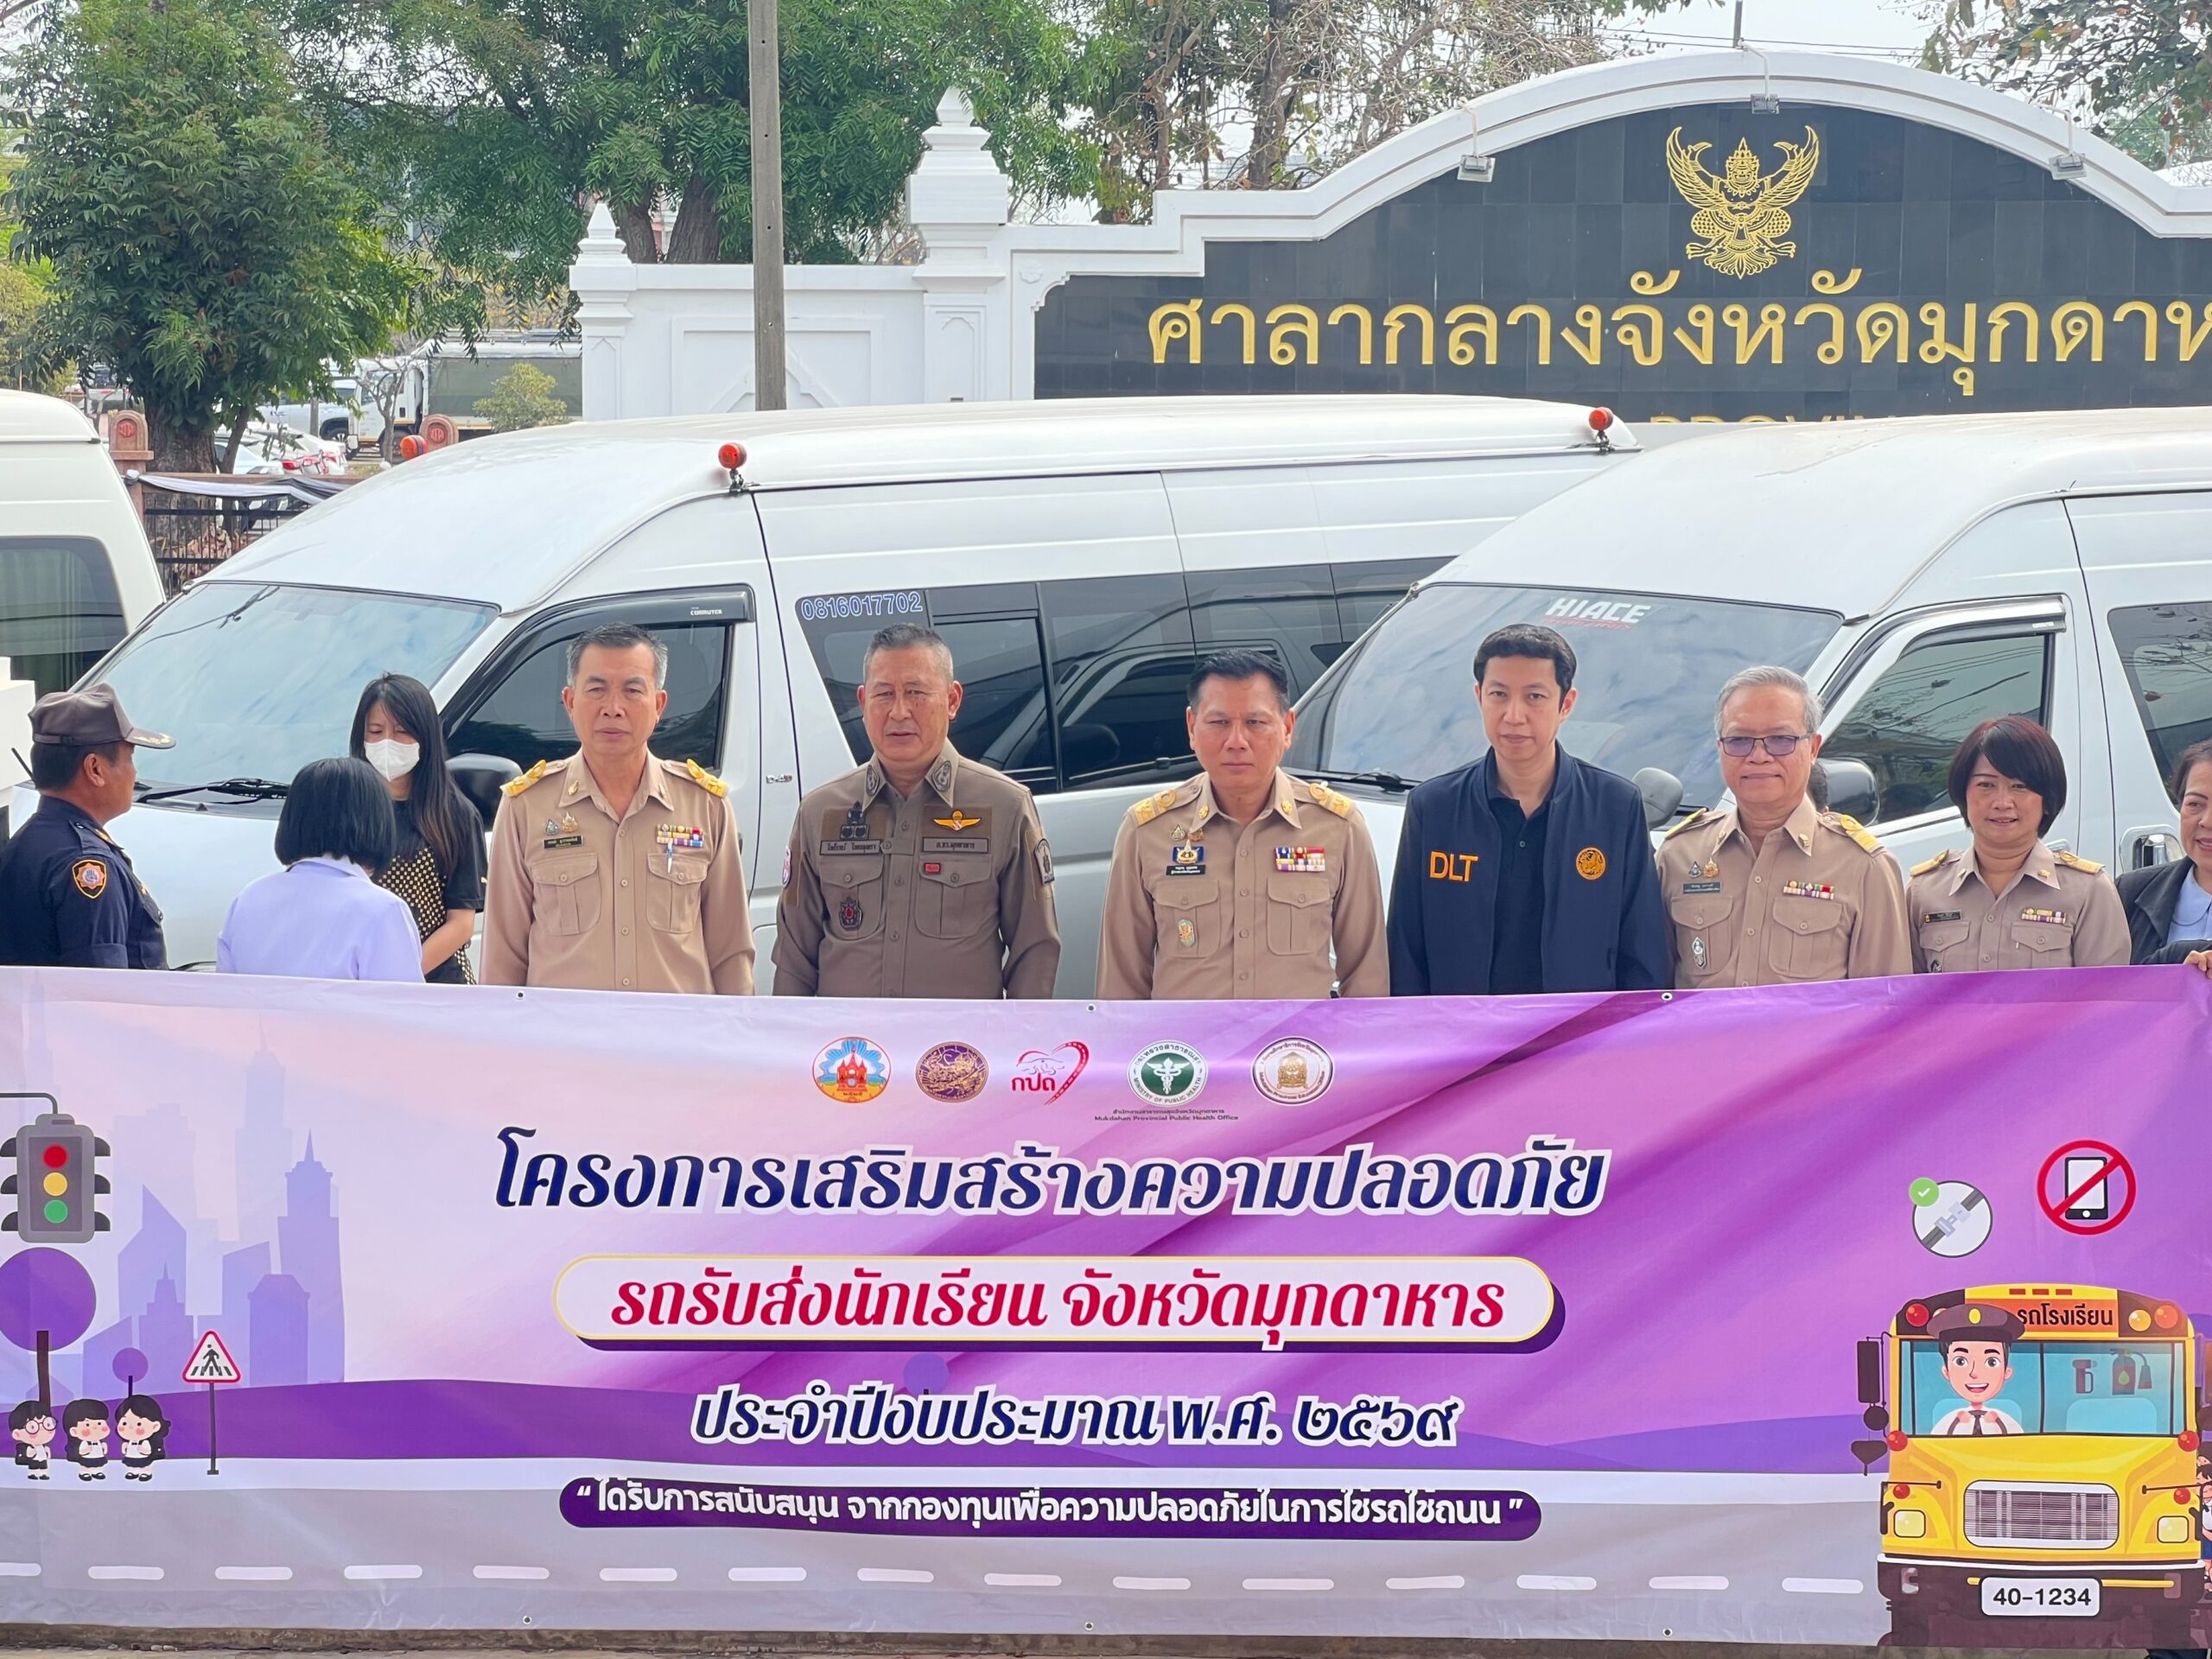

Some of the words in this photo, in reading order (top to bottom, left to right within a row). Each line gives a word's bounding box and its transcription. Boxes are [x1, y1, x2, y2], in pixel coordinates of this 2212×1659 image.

[801, 591, 923, 620] 0816017702
[1545, 598, 1651, 624] HIACE
[1429, 850, 1479, 882] DLT
[1011, 1072, 1056, 1092] กปถ
[1164, 1095, 1186, 1103] PUBLIC
[495, 1126, 1605, 1211] โครงการเสริมสร้างความปลอดภัย
[611, 1265, 1048, 1327] รถรับส่งนักเรียน
[1062, 1268, 1504, 1346] จังหวัดมุกดาหาร
[2017, 1302, 2113, 1326] รถโรงเรียน
[695, 1384, 1159, 1440] ประจำปีงบประมาณ
[1172, 1396, 1278, 1440] พ.ศ.
[1993, 1587, 2092, 1607] 40-1234
